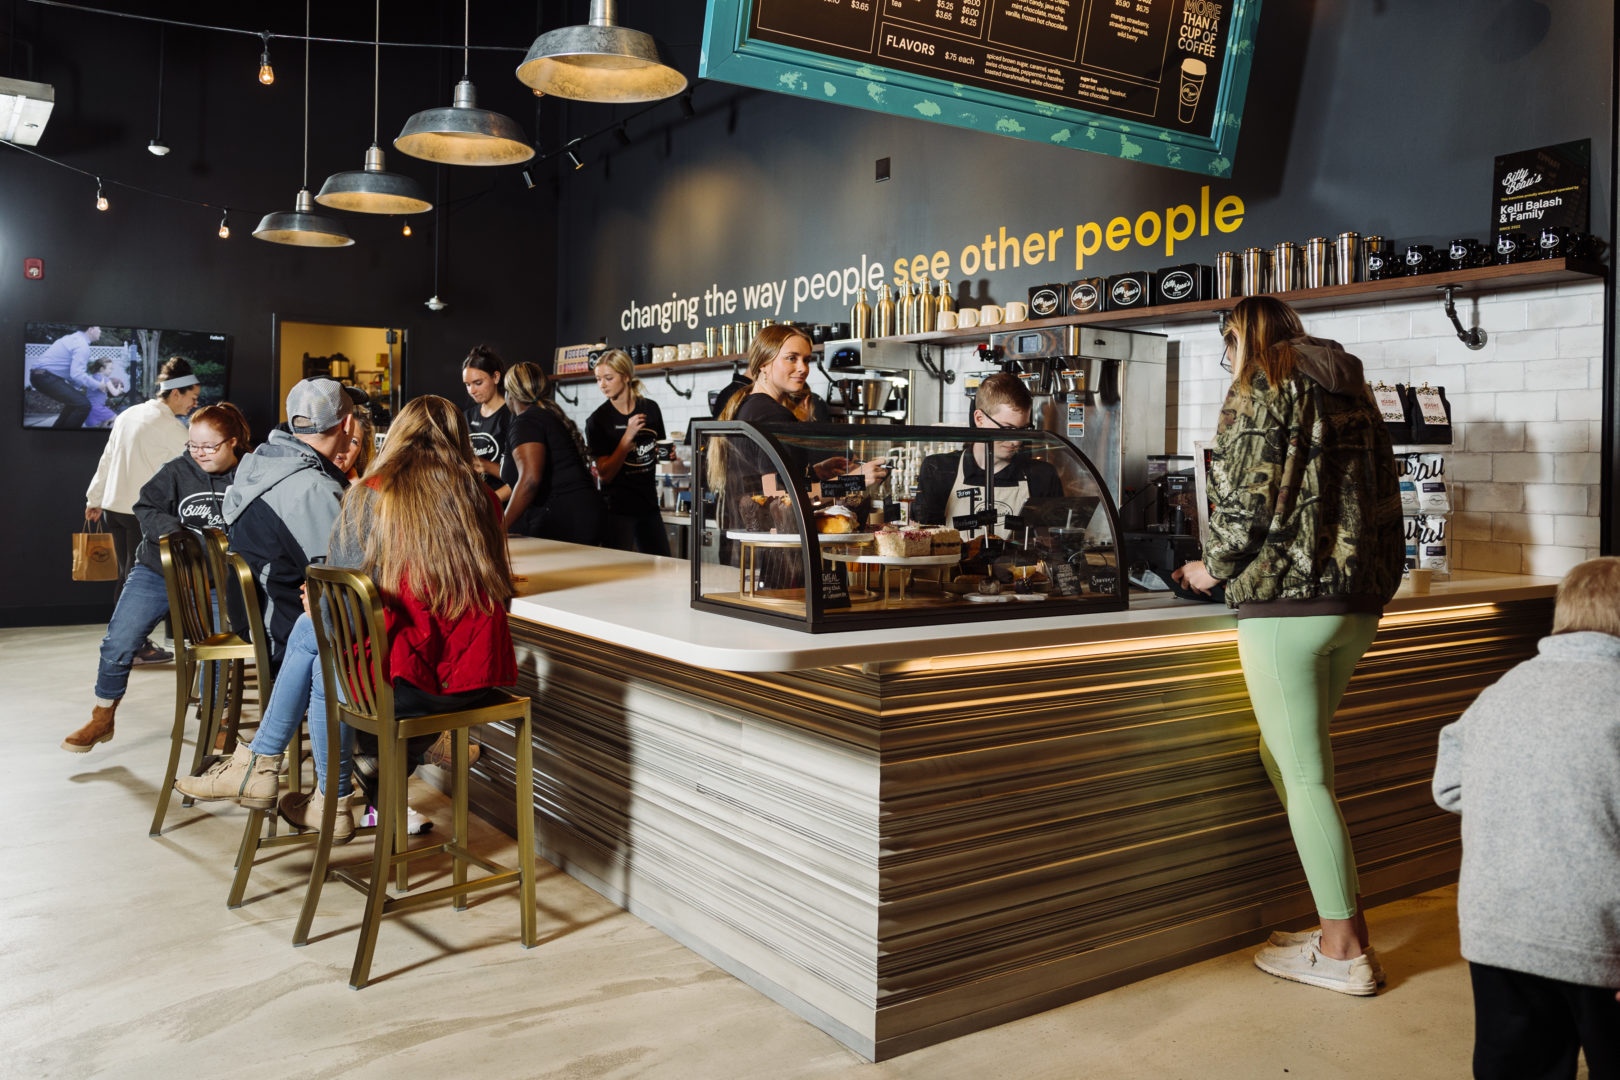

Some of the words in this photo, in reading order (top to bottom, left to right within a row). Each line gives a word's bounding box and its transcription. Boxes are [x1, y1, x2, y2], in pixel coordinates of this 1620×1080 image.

[851, 0, 869, 11] $3.65
[962, 6, 979, 16] $6.00
[1184, 0, 1222, 20] MORE
[961, 16, 976, 27] $4.25
[1183, 11, 1210, 29] THAN
[1211, 20, 1218, 32] A
[1180, 25, 1201, 40] CUP
[1203, 31, 1216, 44] OF
[887, 35, 935, 56] FLAVORS
[945, 52, 957, 61] $.75
[958, 56, 974, 65] each
[1178, 38, 1216, 57] COFFEE
[1502, 168, 1529, 186] Bitty
[1506, 173, 1542, 194] Beau's
[1501, 202, 1523, 214] Kelli
[1526, 197, 1562, 210] Balash
[1500, 214, 1507, 223] &
[1510, 209, 1544, 221] Family
[621, 292, 700, 333] changing
[704, 284, 736, 317] the
[743, 280, 786, 316] way
[794, 254, 884, 313] people
[894, 251, 949, 287] see
[960, 227, 1063, 275] other
[1076, 186, 1244, 270] people
[182, 504, 211, 519] Bitty
